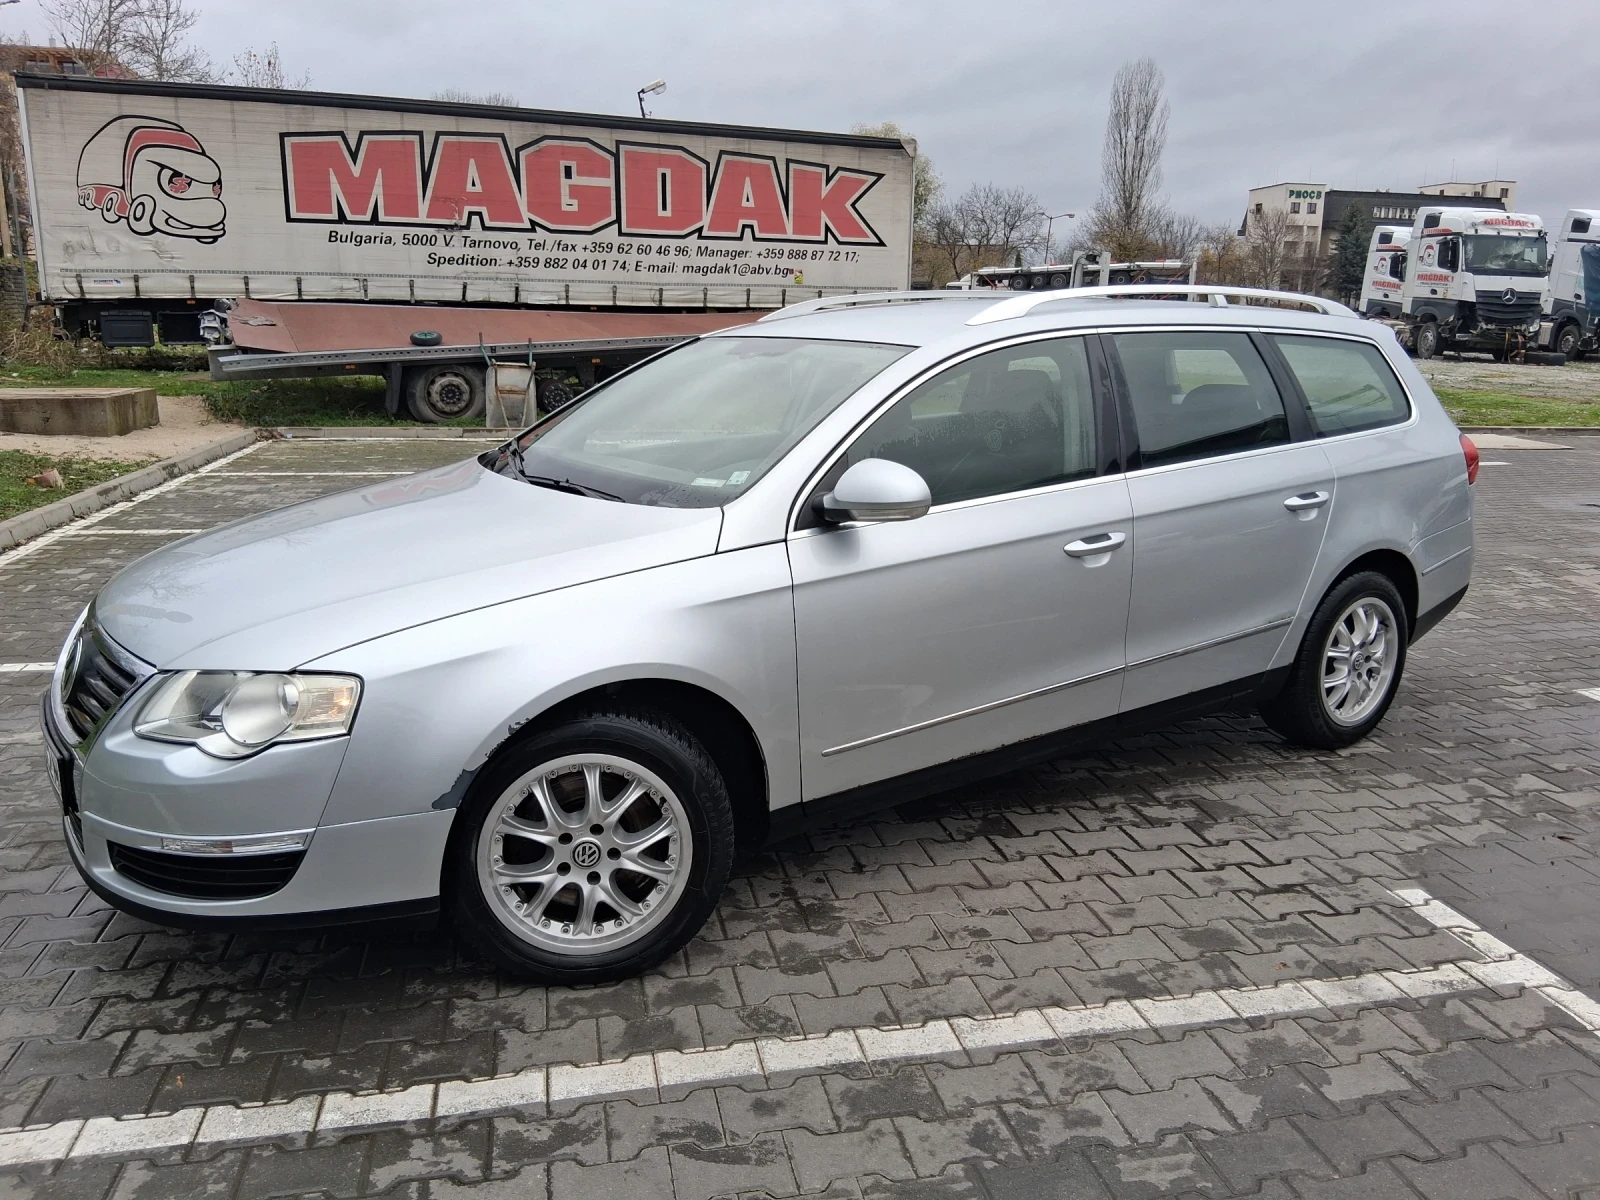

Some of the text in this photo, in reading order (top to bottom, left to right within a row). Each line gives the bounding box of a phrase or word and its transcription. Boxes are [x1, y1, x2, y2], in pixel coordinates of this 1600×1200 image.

[279, 130, 887, 247] MAGDAK
[328, 230, 860, 264] Bulgaria, 5000 V. Tarnovo, Tel./fax +359 62 60 46 96; Manager: +359 888 87 72 17;
[426, 252, 502, 268] Spedition:
[506, 256, 540, 269] +359
[543, 257, 568, 270] 882
[572, 258, 588, 270] 04
[592, 259, 607, 271] 01
[612, 260, 631, 273] 74;
[634, 260, 679, 274] E-mail:
[681, 263, 790, 278] magdak1@abv.bg
